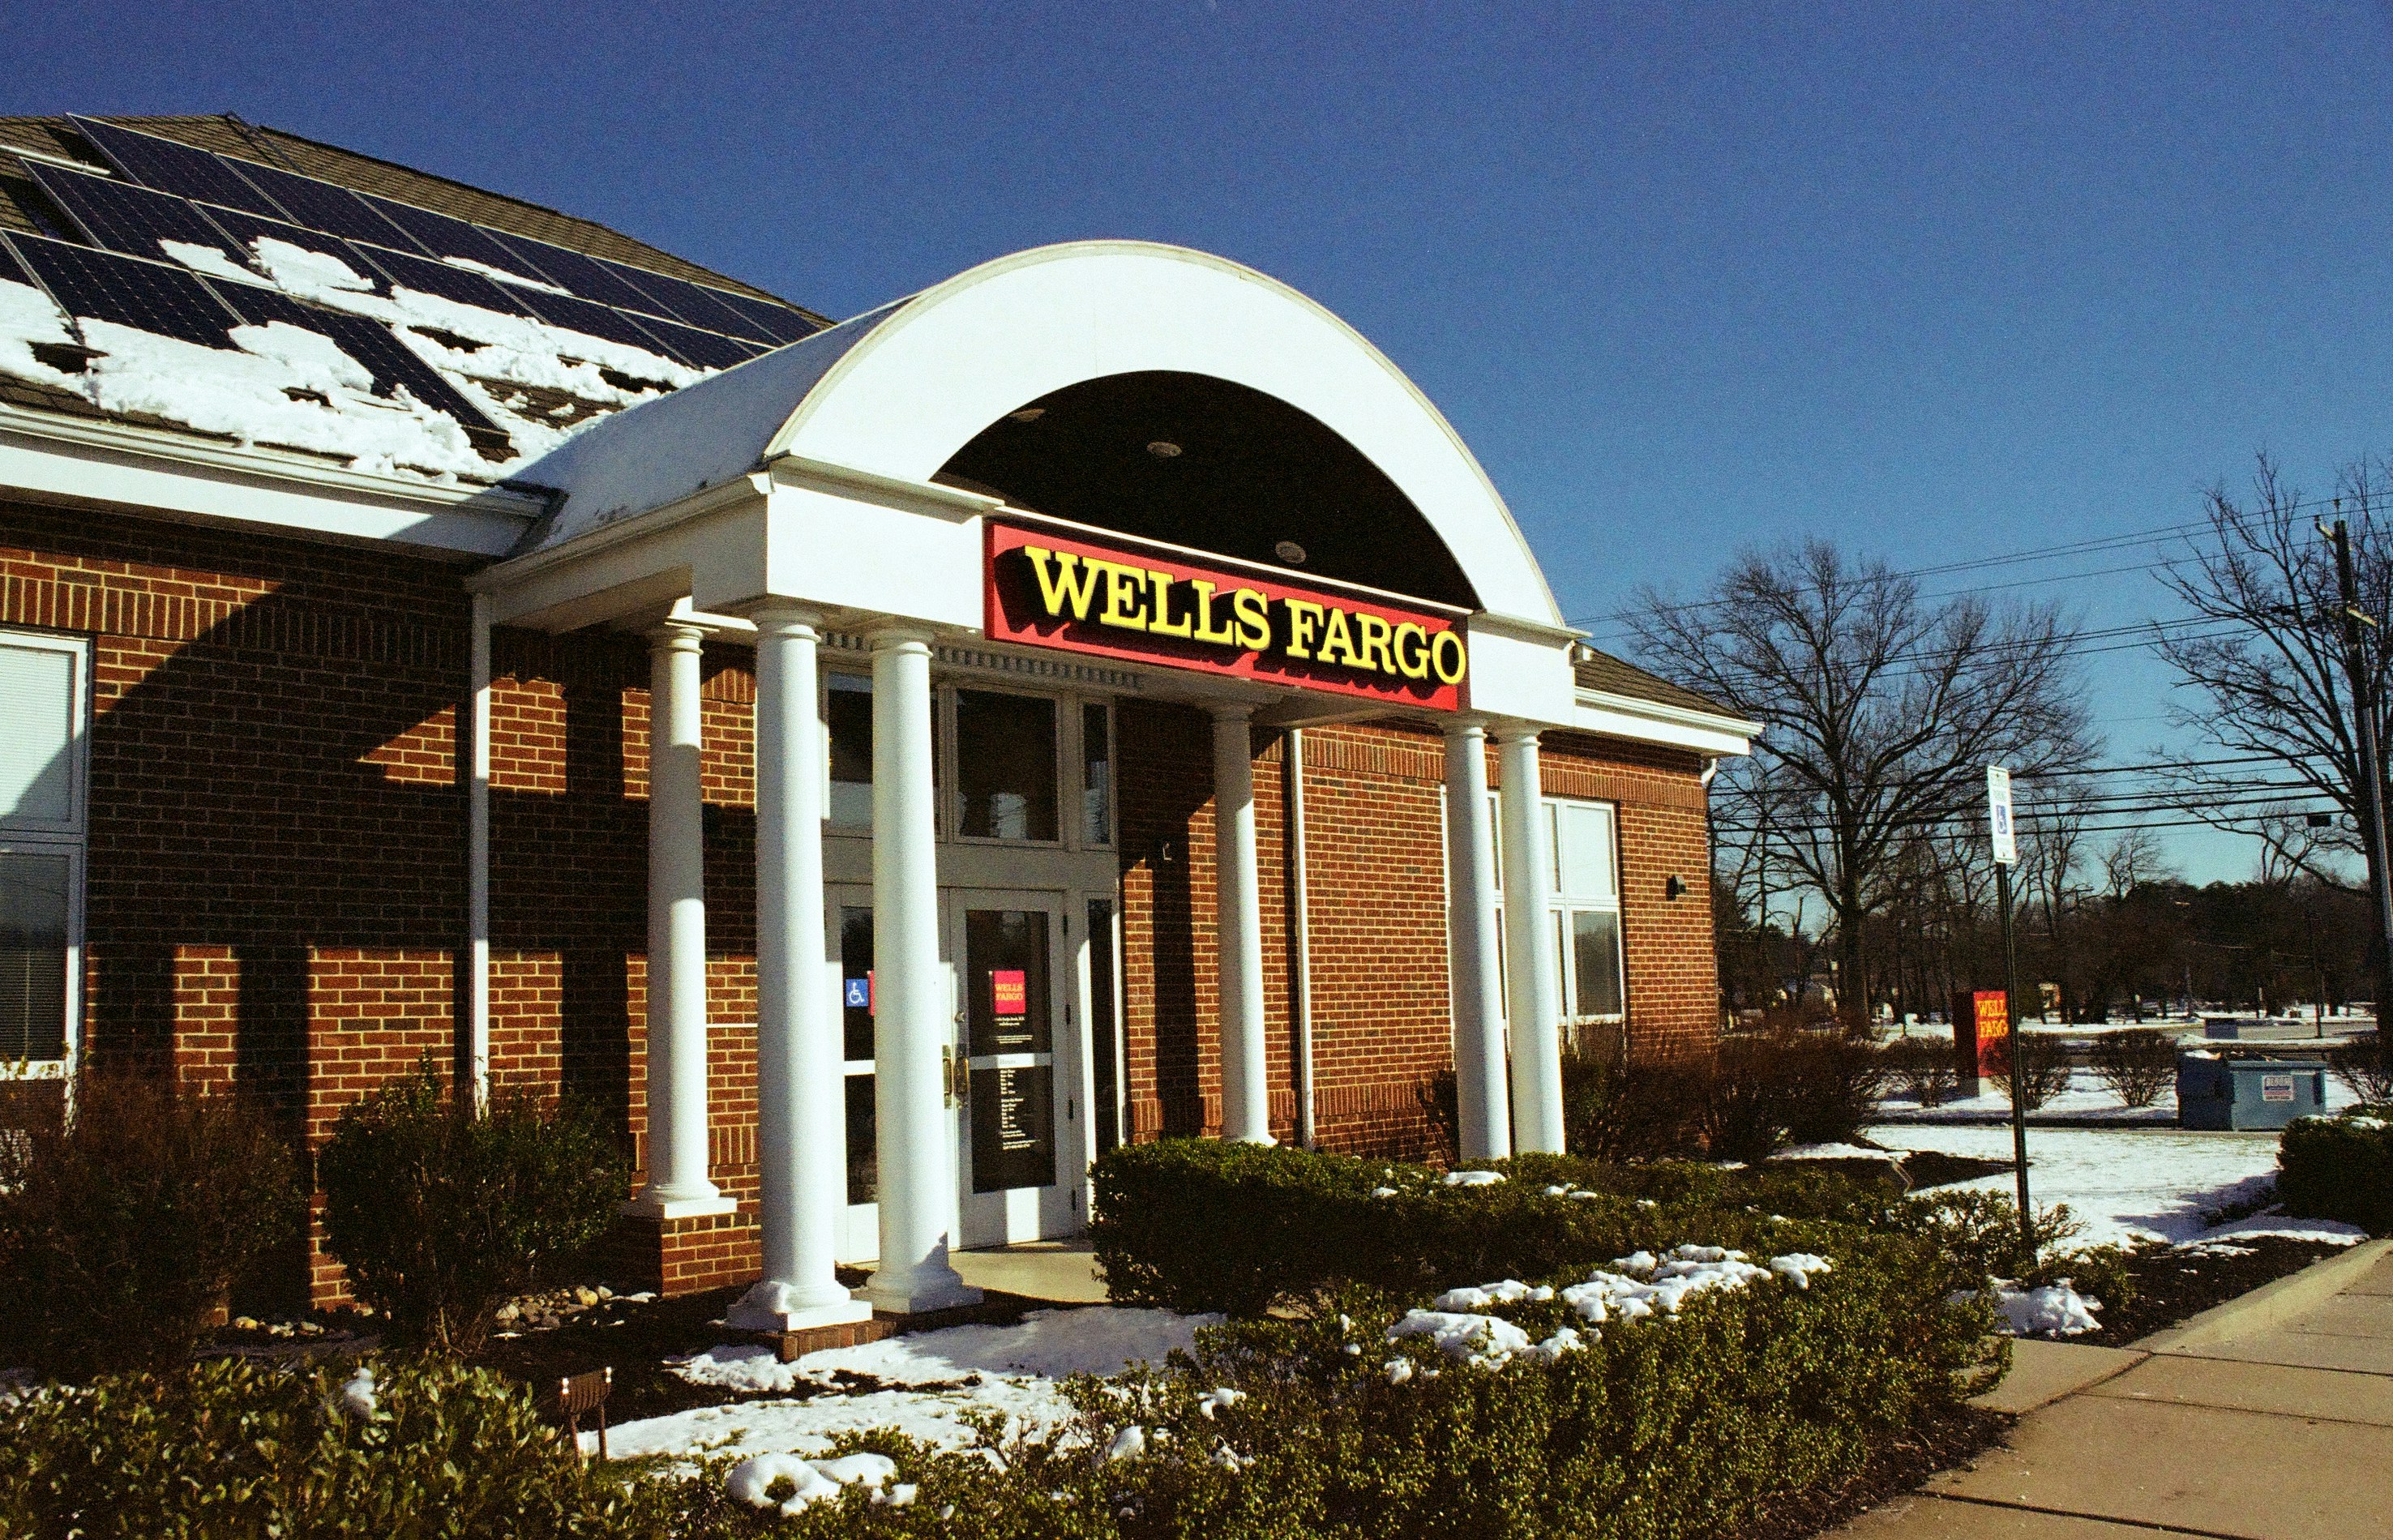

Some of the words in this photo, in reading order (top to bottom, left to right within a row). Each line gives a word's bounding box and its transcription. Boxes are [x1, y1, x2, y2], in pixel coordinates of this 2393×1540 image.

[1025, 545, 1271, 651] WELLS
[1286, 597, 1466, 686] FARGO
[995, 983, 1023, 991] WELLS
[995, 992, 1024, 1001] FARGO
[1977, 999, 2008, 1017] WELL
[1980, 1020, 2009, 1038] FARG
